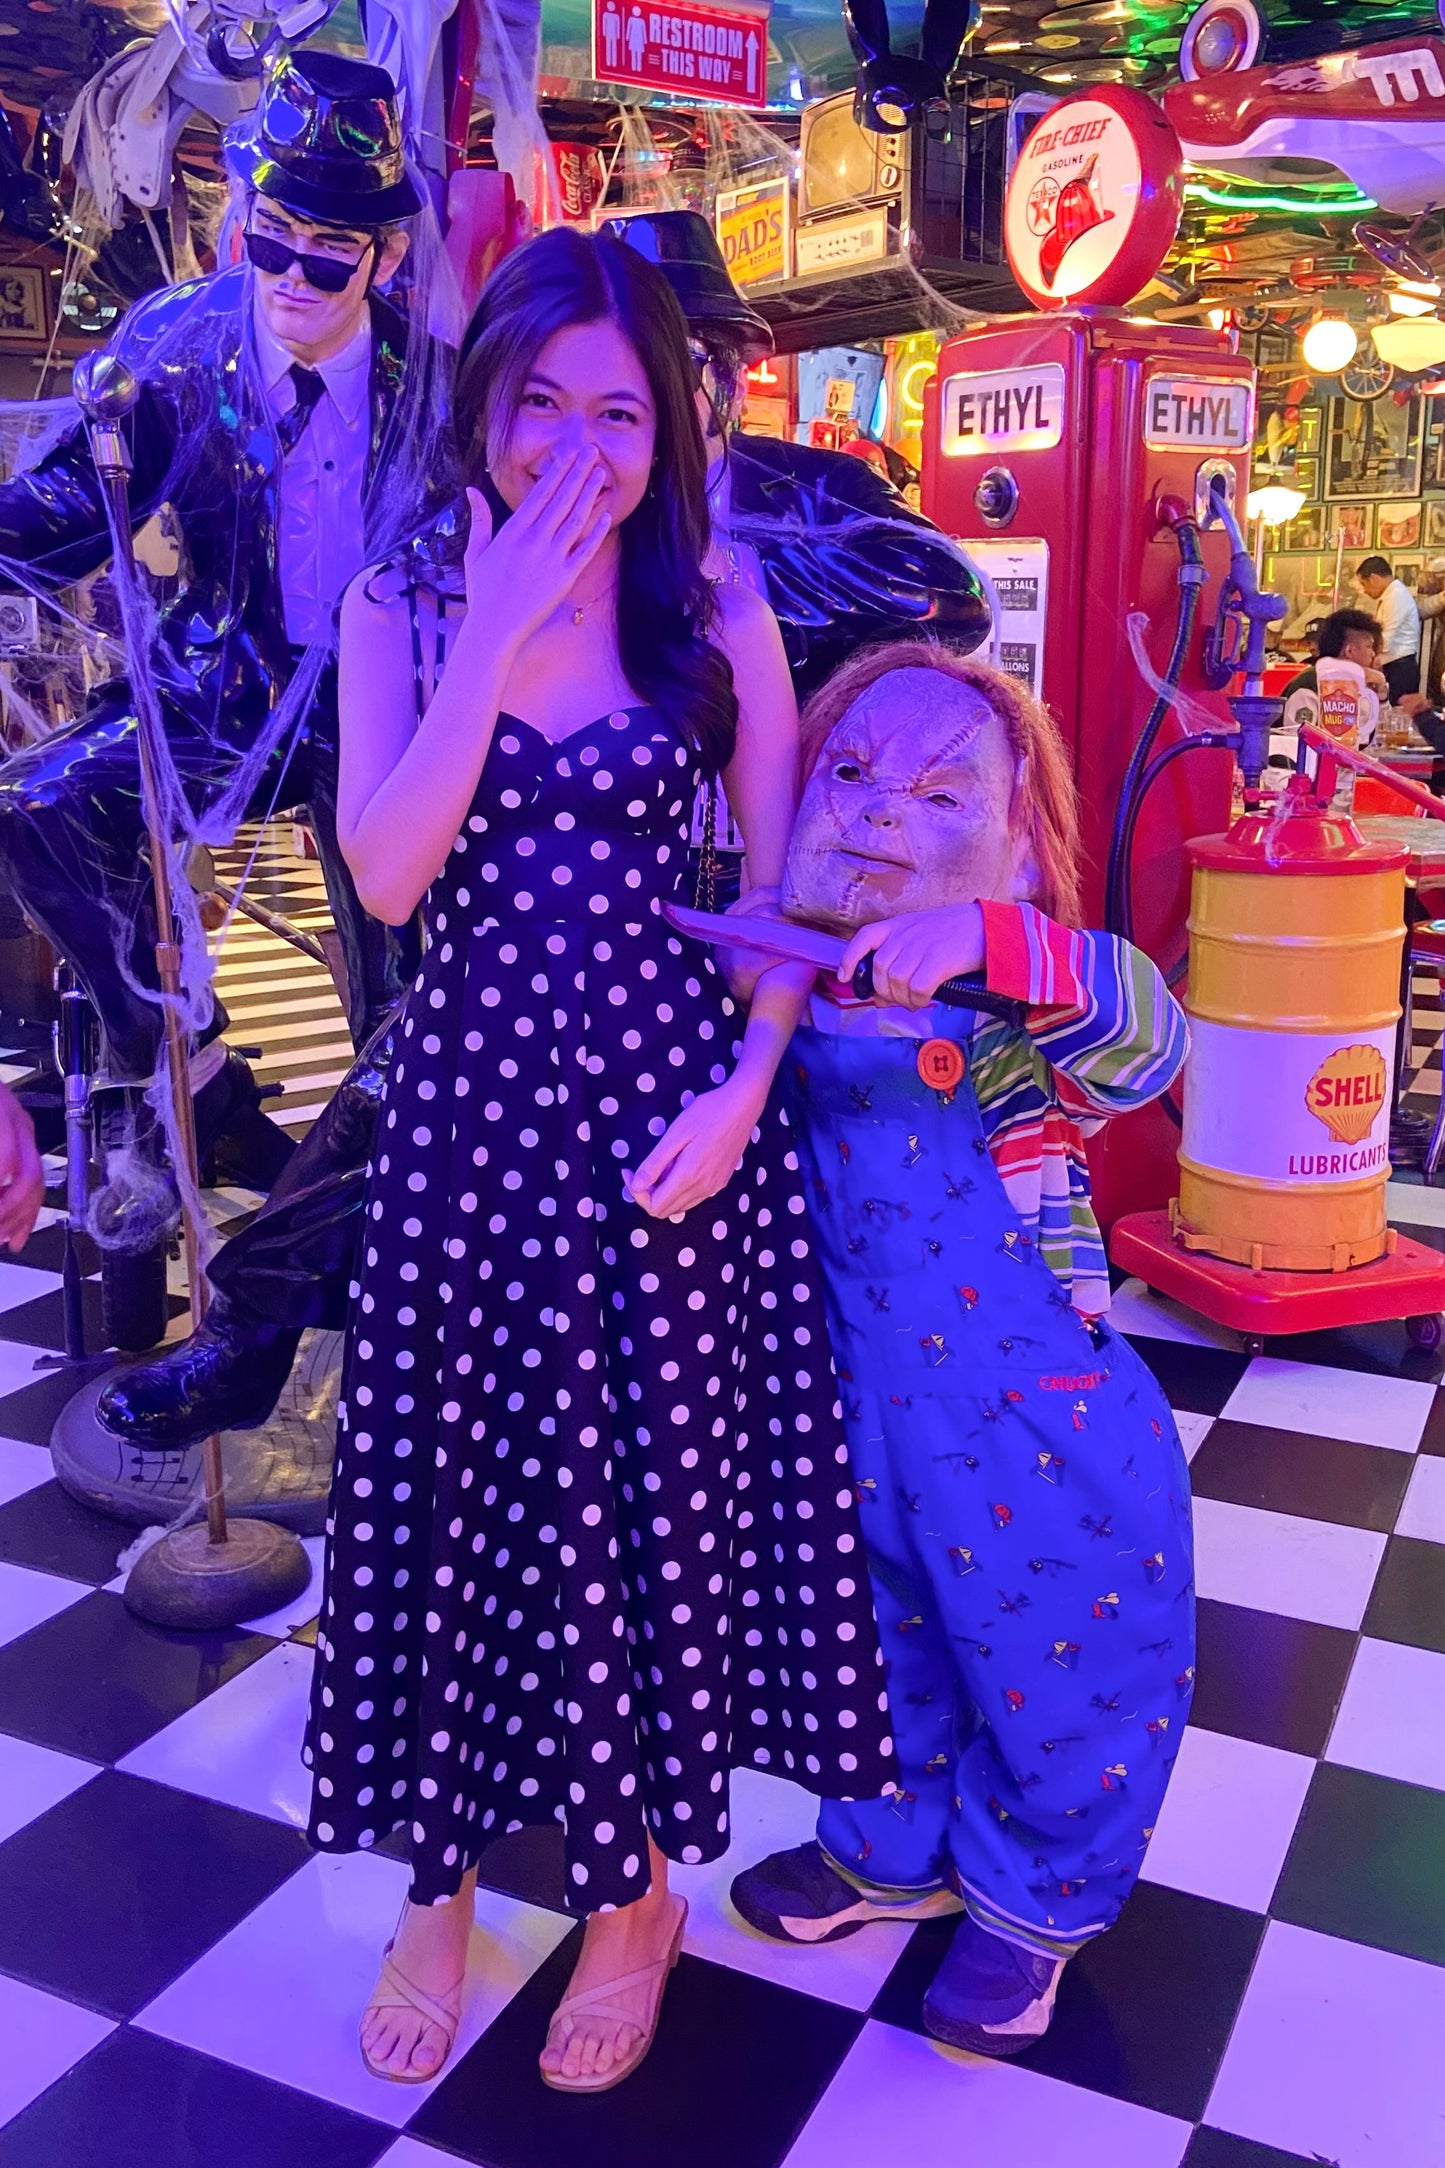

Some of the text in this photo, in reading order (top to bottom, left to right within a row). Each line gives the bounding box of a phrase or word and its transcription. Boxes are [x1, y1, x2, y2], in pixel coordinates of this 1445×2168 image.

[649, 13, 743, 59] RESTROOM
[661, 48, 731, 84] THIS WAY
[1029, 117, 1113, 158] FIRE-CHIEF
[1042, 154, 1084, 173] GASOLINE
[1032, 186, 1058, 198] TEXACO
[723, 208, 782, 265] DAD'S
[958, 385, 1050, 437] ETHYL
[1152, 393, 1239, 437] ETHYL
[994, 580, 1035, 590] THIS SALE
[1001, 662, 1030, 673] ALLONS
[1323, 700, 1356, 714] MACHO
[1325, 713, 1343, 725] MUG
[1314, 1072, 1382, 1108] SHELL
[1289, 1142, 1387, 1175] LUBRICANTS
